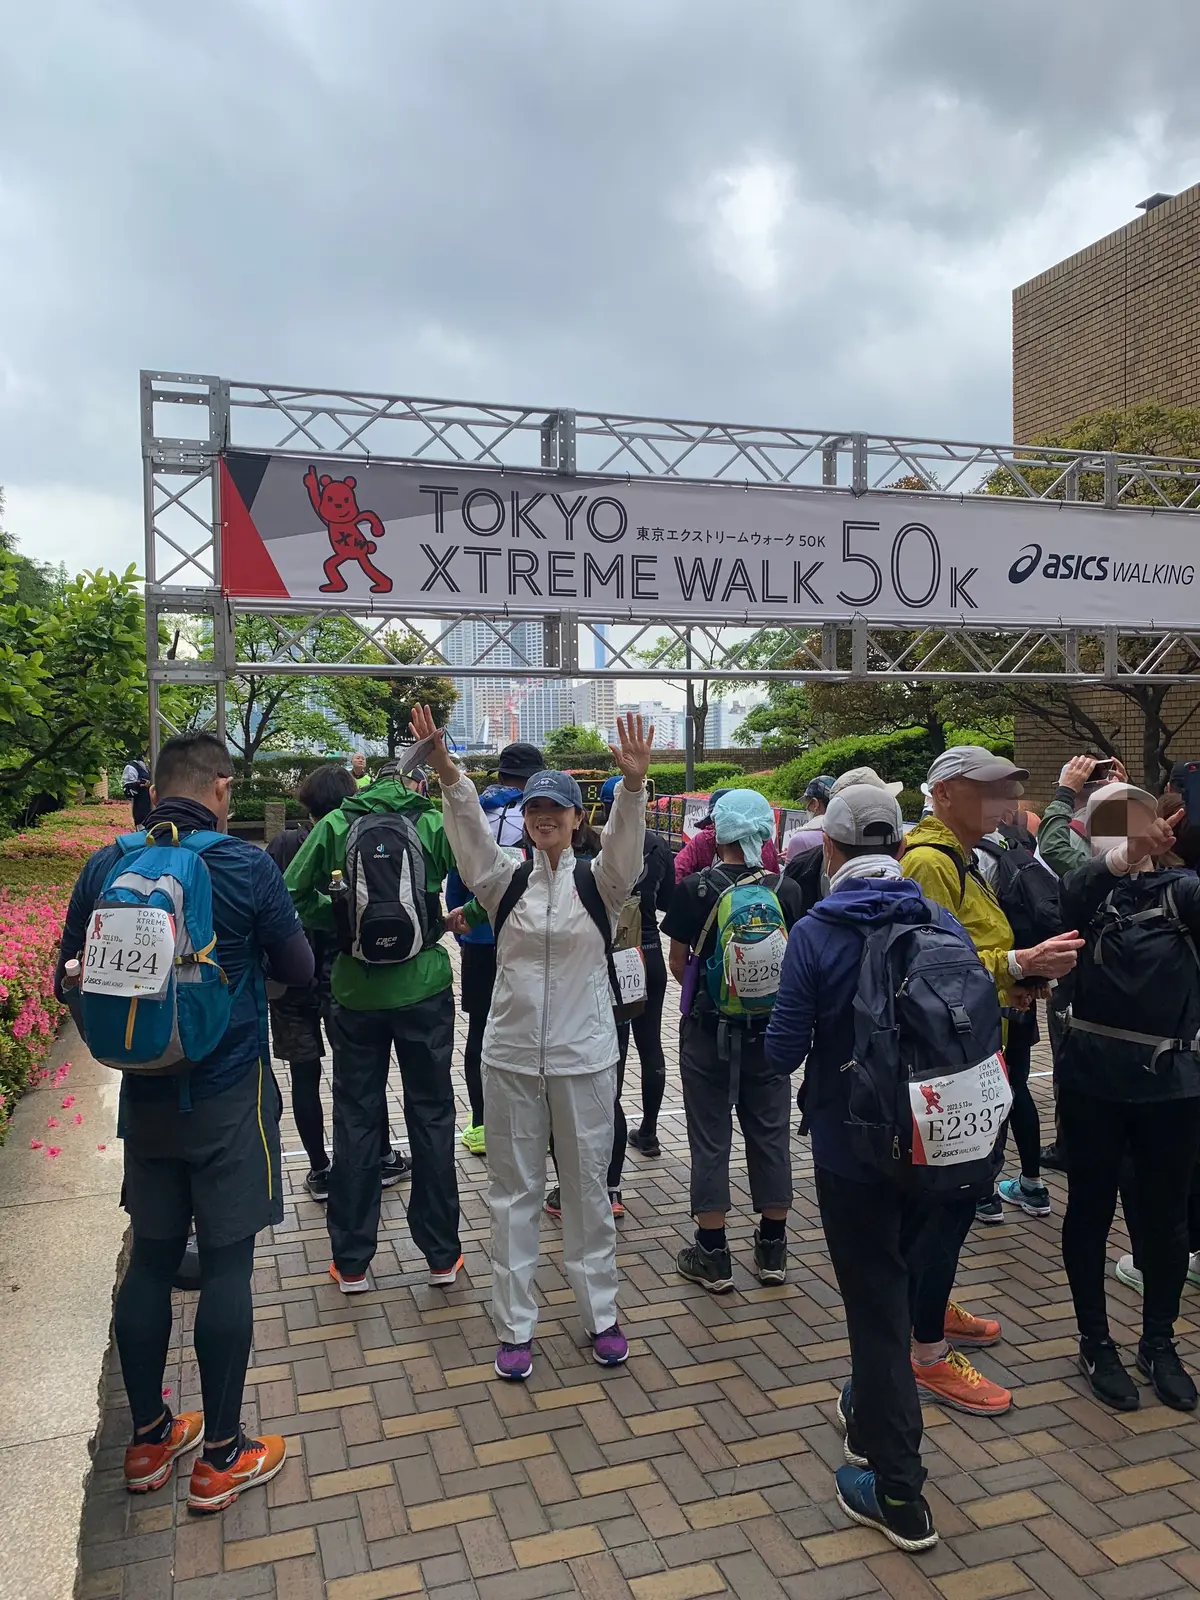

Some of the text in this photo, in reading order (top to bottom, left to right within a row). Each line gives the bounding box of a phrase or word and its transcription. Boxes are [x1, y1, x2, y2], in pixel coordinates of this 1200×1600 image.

[419, 485, 628, 543] TOKYO
[636, 526, 826, 548] 東京エクストリームウォーク 50K
[419, 544, 659, 600] XTREME
[674, 556, 824, 604] WALK
[1113, 562, 1195, 585] WALKING
[136, 918, 166, 927] XTREME
[137, 910, 167, 919] TOKYO
[136, 925, 165, 933] WALK
[86, 945, 158, 975] B1424
[736, 962, 780, 983] E228
[619, 973, 640, 990] 076
[979, 1059, 999, 1072] TOKYO
[979, 1067, 1000, 1080] XTREME
[980, 1076, 1001, 1088] WALK
[927, 1103, 1005, 1142] E2337
[959, 1145, 981, 1155] WALKING
